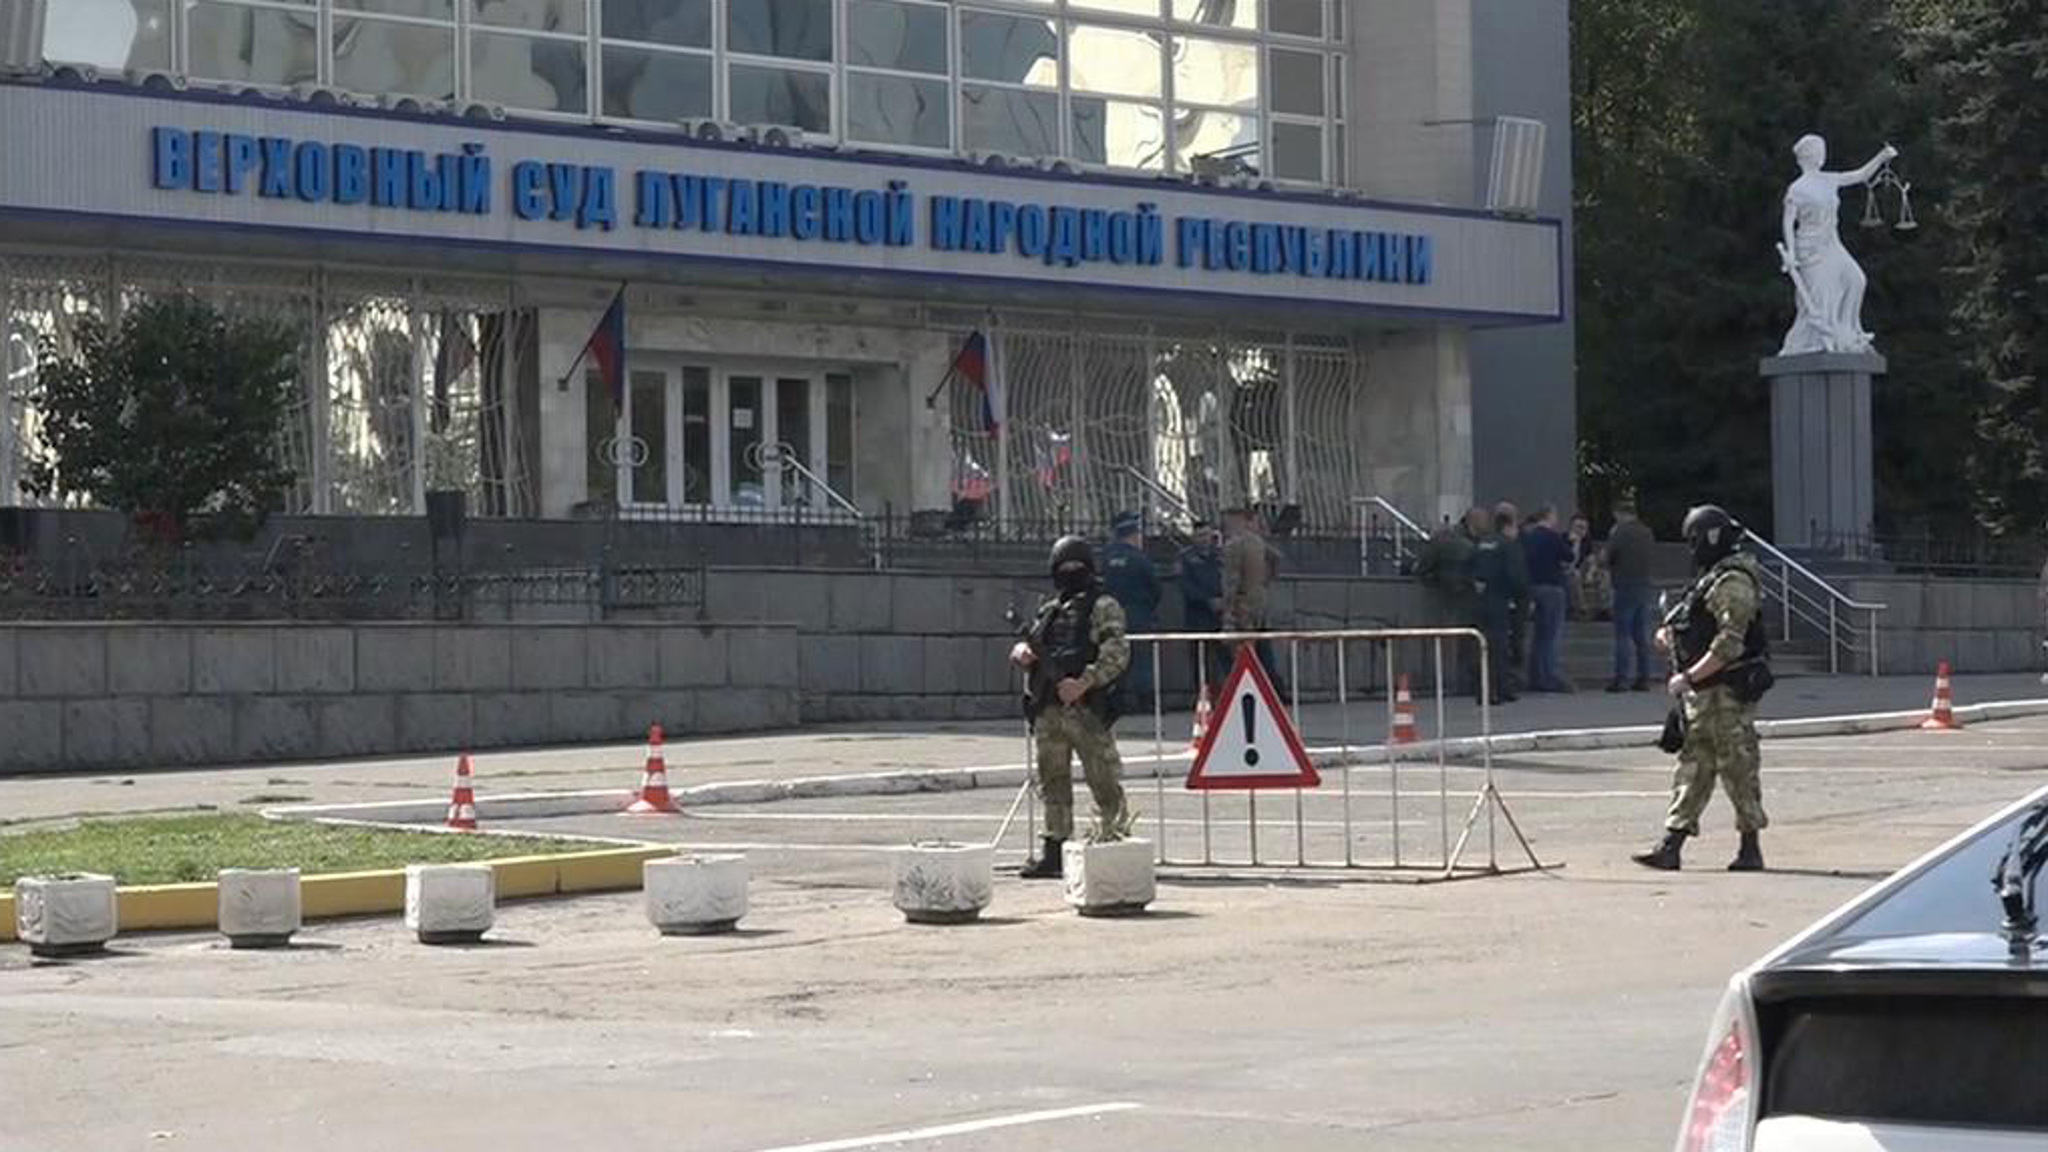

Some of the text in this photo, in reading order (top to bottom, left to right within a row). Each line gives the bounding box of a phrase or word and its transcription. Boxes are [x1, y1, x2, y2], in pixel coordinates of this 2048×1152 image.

[152, 126, 491, 214] ВЕРХОВНЫЙ
[512, 160, 617, 231] СУД
[930, 194, 1163, 268] НАРОДНОЙ
